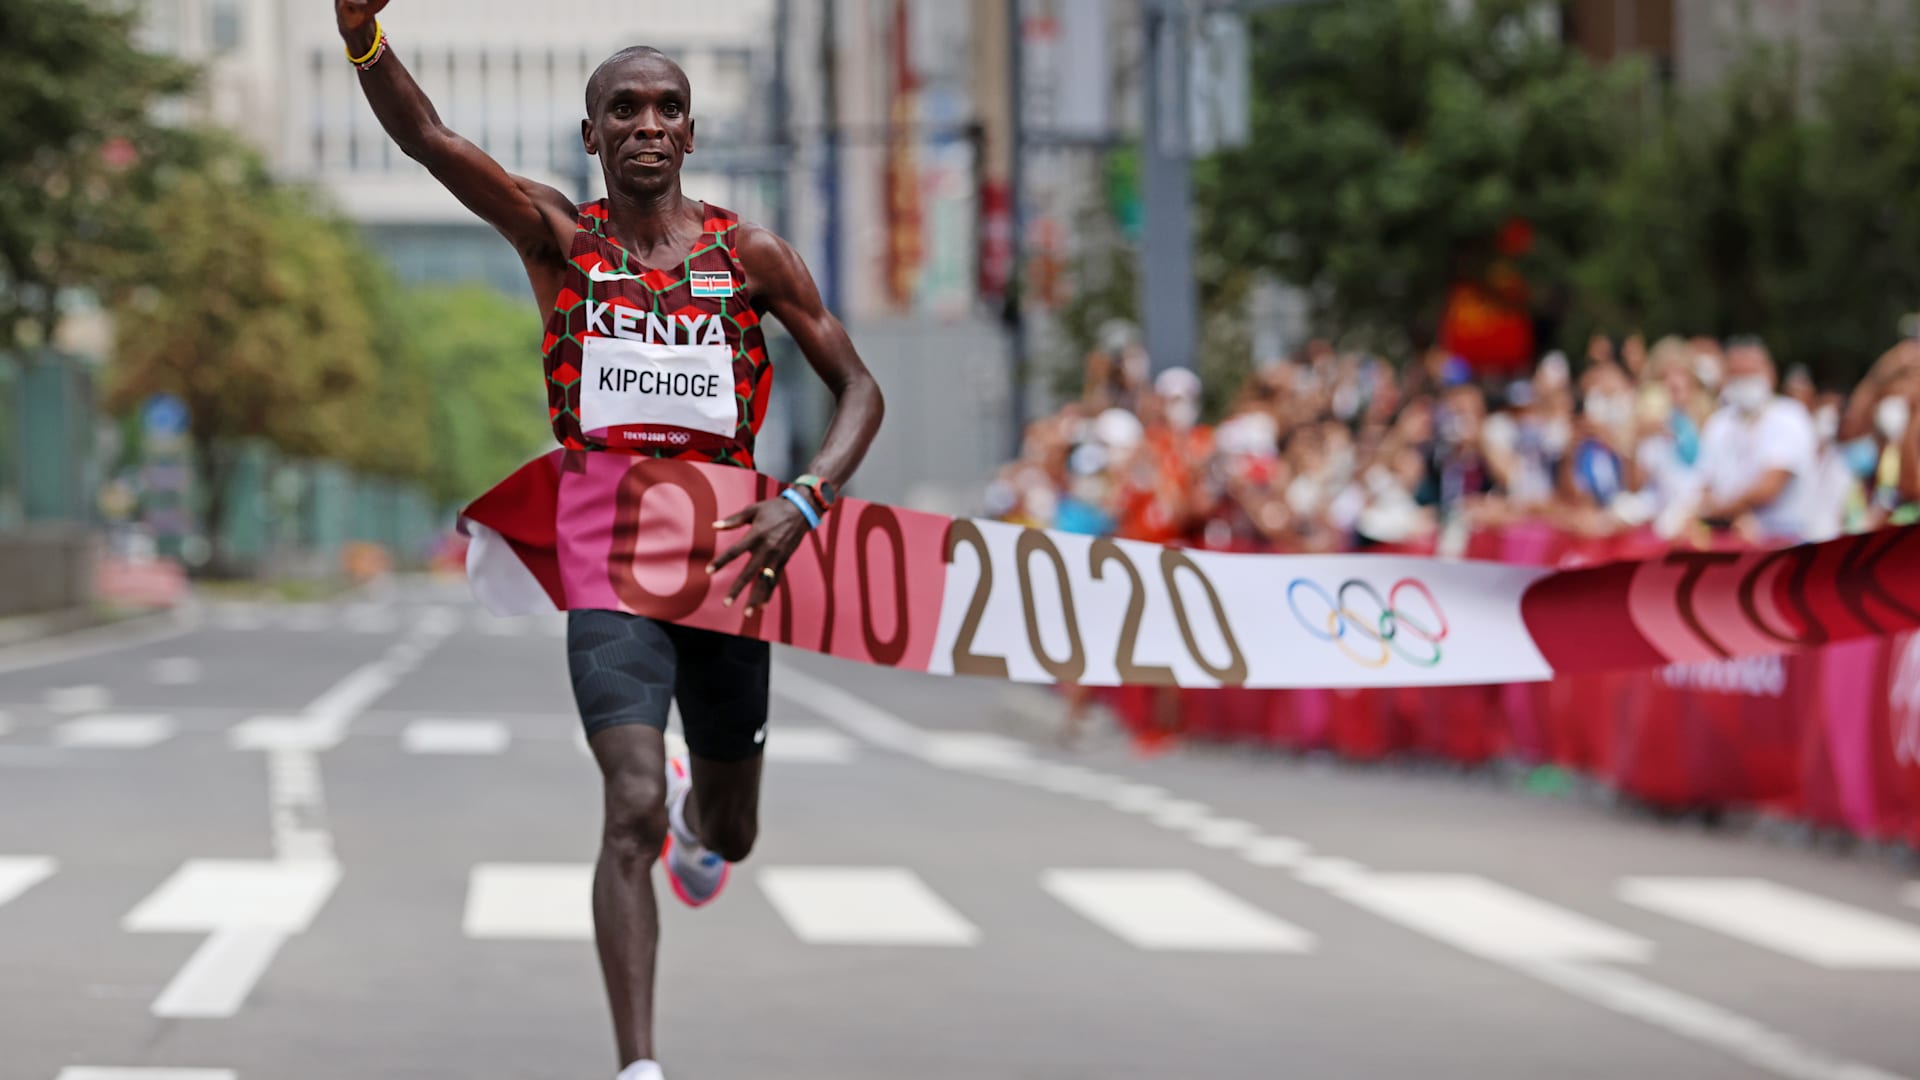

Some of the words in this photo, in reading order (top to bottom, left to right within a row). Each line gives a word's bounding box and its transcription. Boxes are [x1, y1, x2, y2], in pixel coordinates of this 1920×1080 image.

[586, 298, 727, 346] KENYA
[599, 367, 720, 397] KIPCHOGE
[623, 431, 647, 441] TOKYO
[648, 432, 666, 442] 2020
[561, 450, 910, 668] OYO
[942, 518, 1248, 687] 2020
